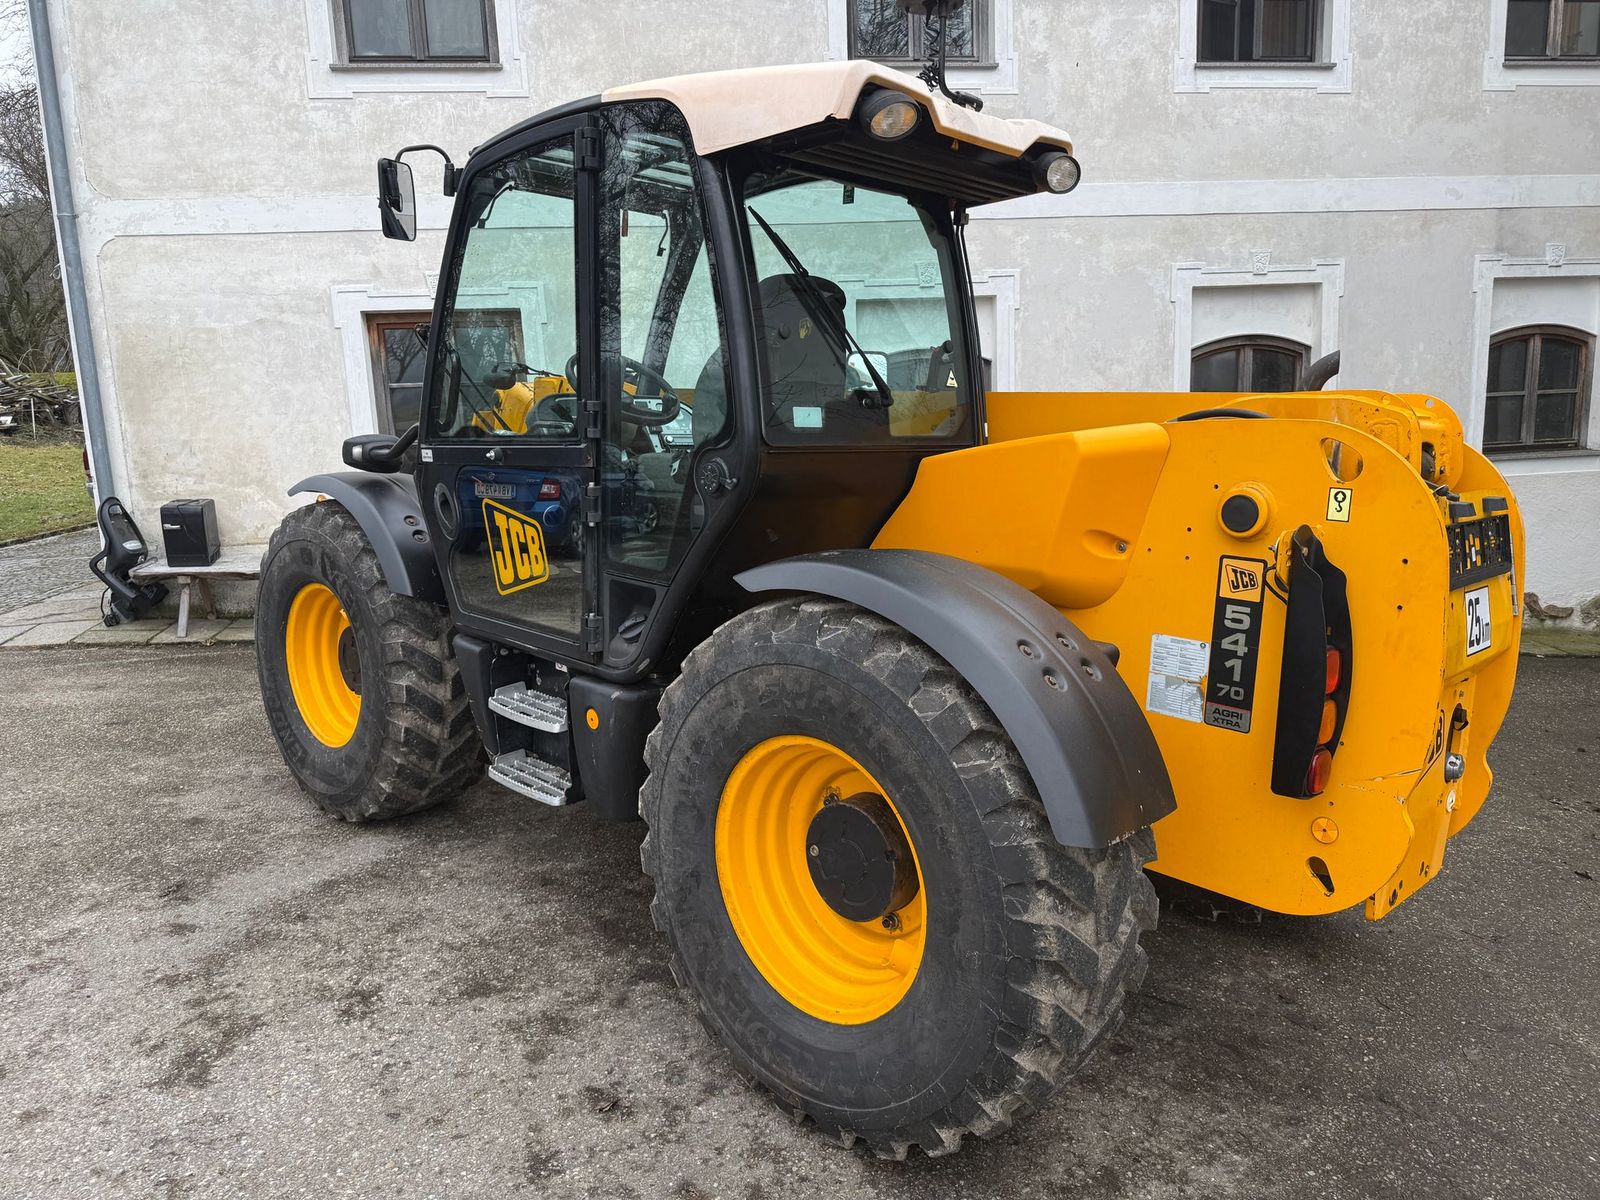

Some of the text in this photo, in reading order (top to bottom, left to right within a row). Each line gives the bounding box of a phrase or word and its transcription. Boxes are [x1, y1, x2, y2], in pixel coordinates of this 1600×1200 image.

[493, 510, 545, 585] JCB
[1231, 567, 1257, 590] JCB
[1468, 597, 1481, 648] 25
[1216, 683, 1245, 701] 70
[1212, 706, 1243, 721] AGRI
[1212, 716, 1241, 729] XTRA
